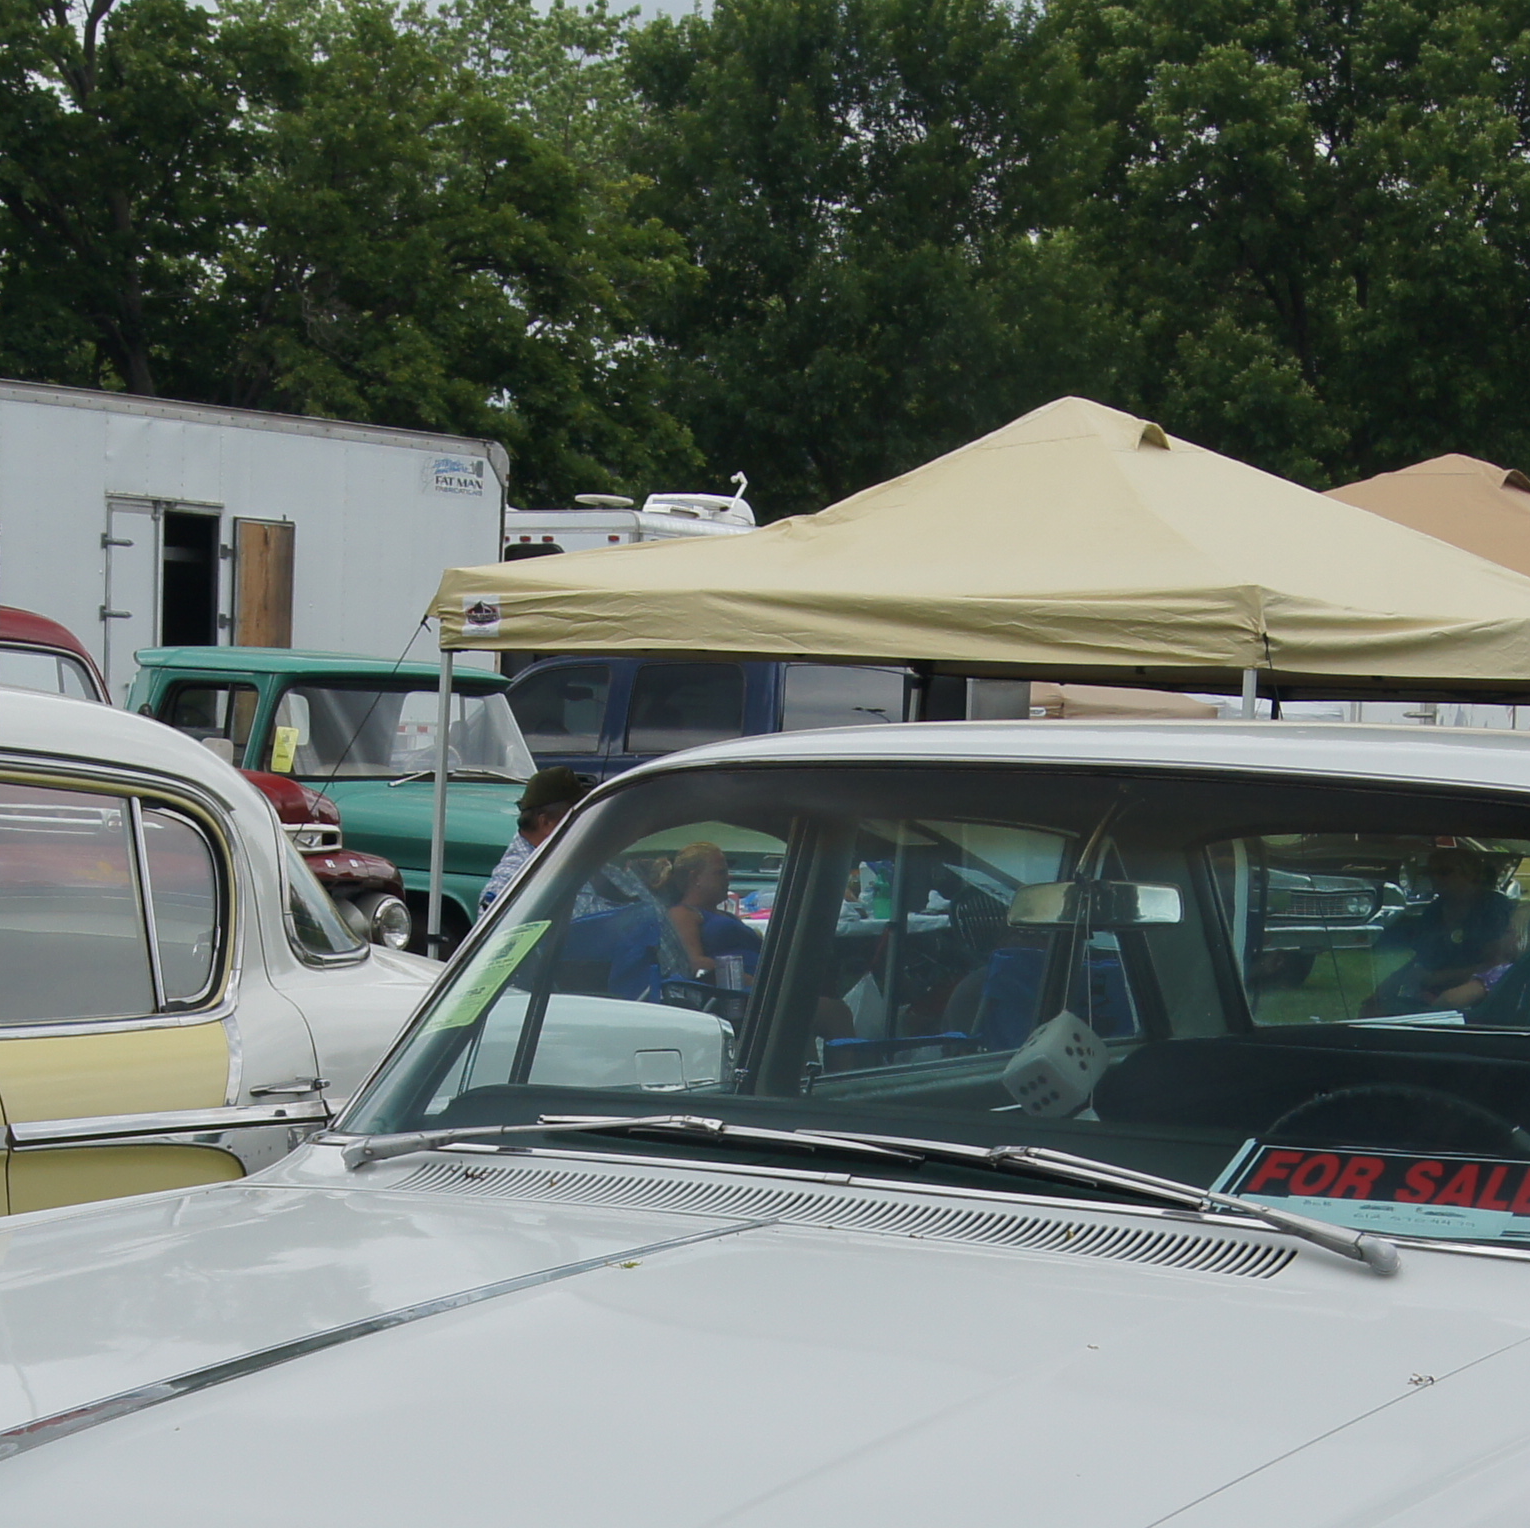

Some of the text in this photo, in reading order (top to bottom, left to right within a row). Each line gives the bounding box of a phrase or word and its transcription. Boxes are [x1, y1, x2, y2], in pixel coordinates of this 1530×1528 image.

[435, 475, 484, 490] FAT MAN
[1246, 1150, 1384, 1200] FOR
